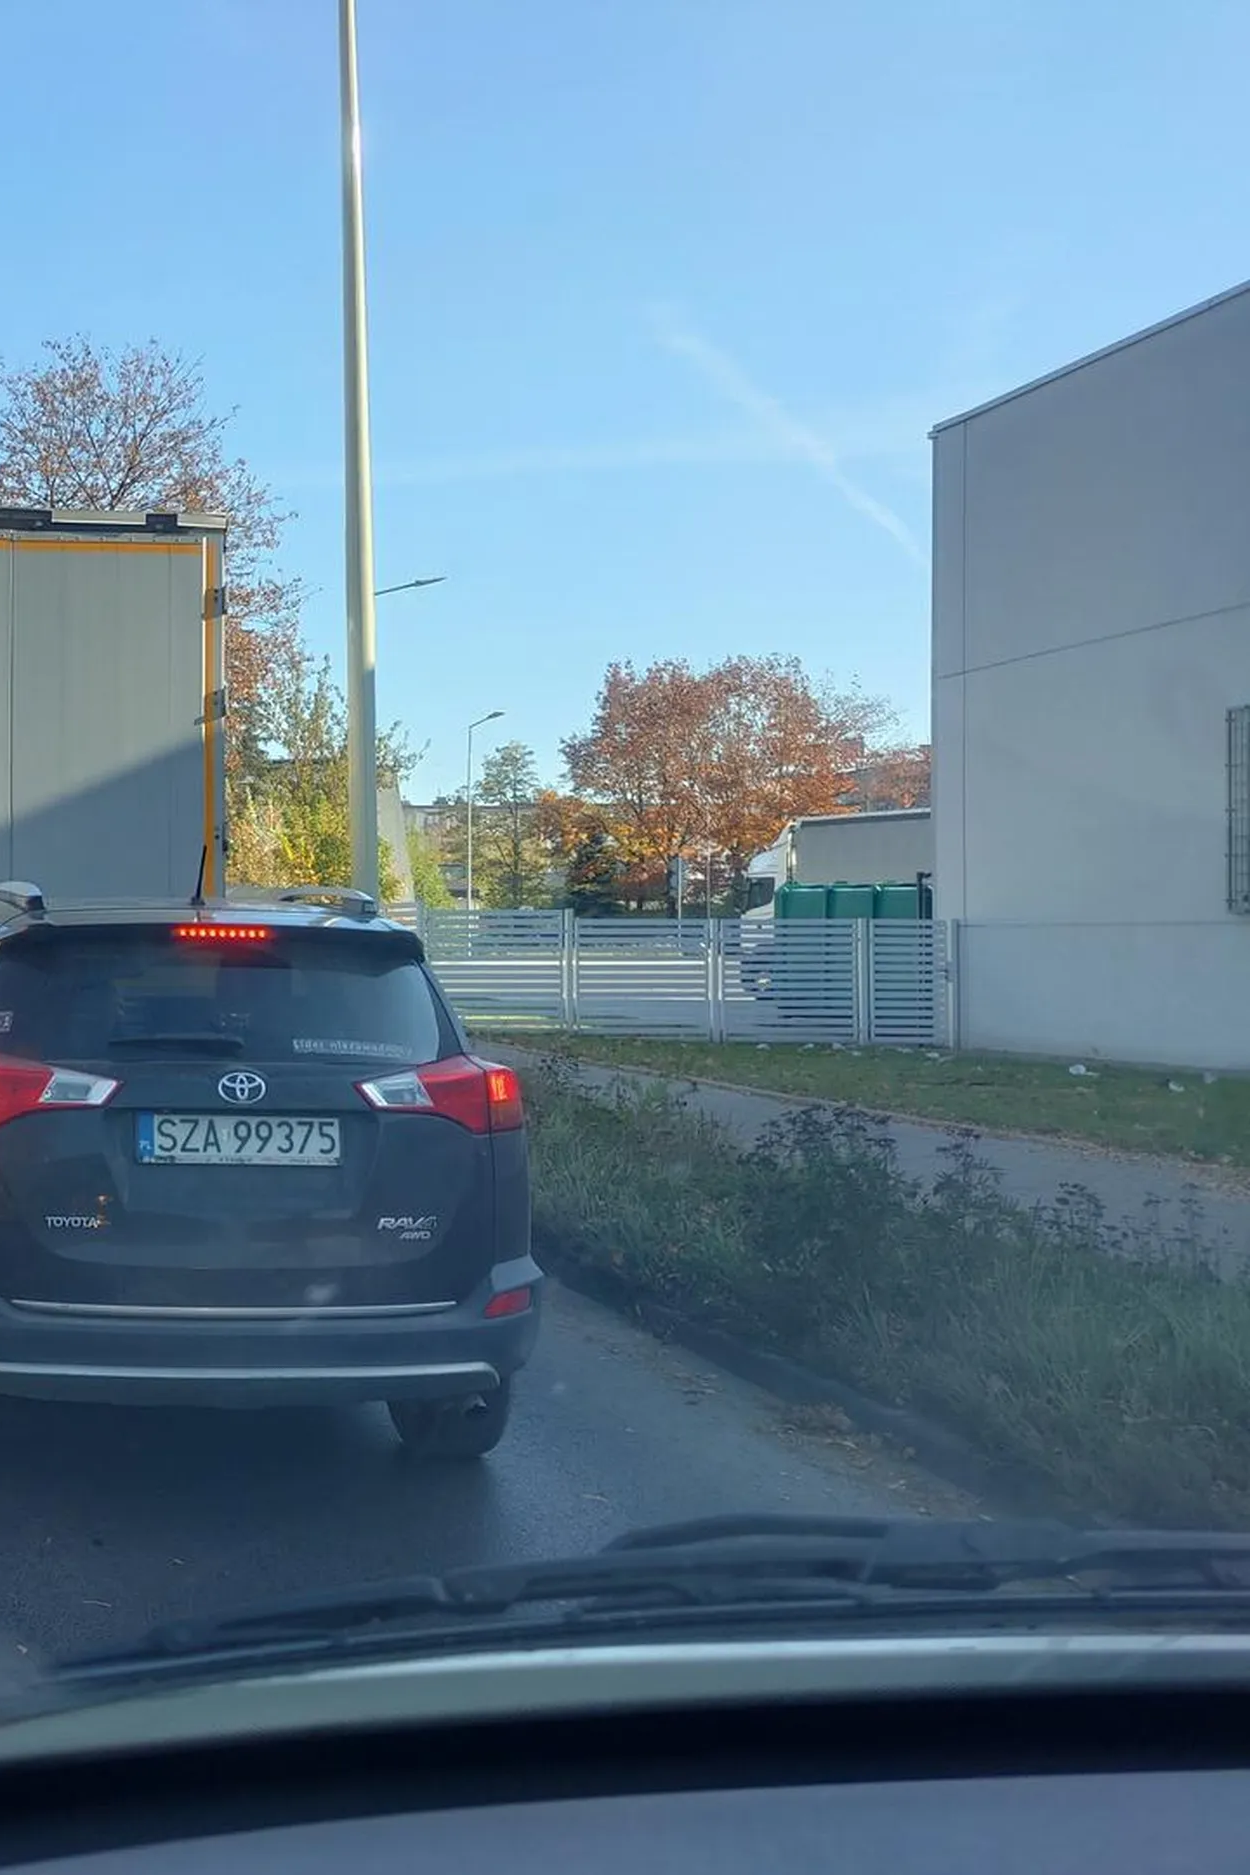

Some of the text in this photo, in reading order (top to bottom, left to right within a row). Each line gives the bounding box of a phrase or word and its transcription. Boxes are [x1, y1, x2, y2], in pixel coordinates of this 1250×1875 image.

[157, 1118, 336, 1154] SZA 99375
[45, 1216, 99, 1229] TOYOTA
